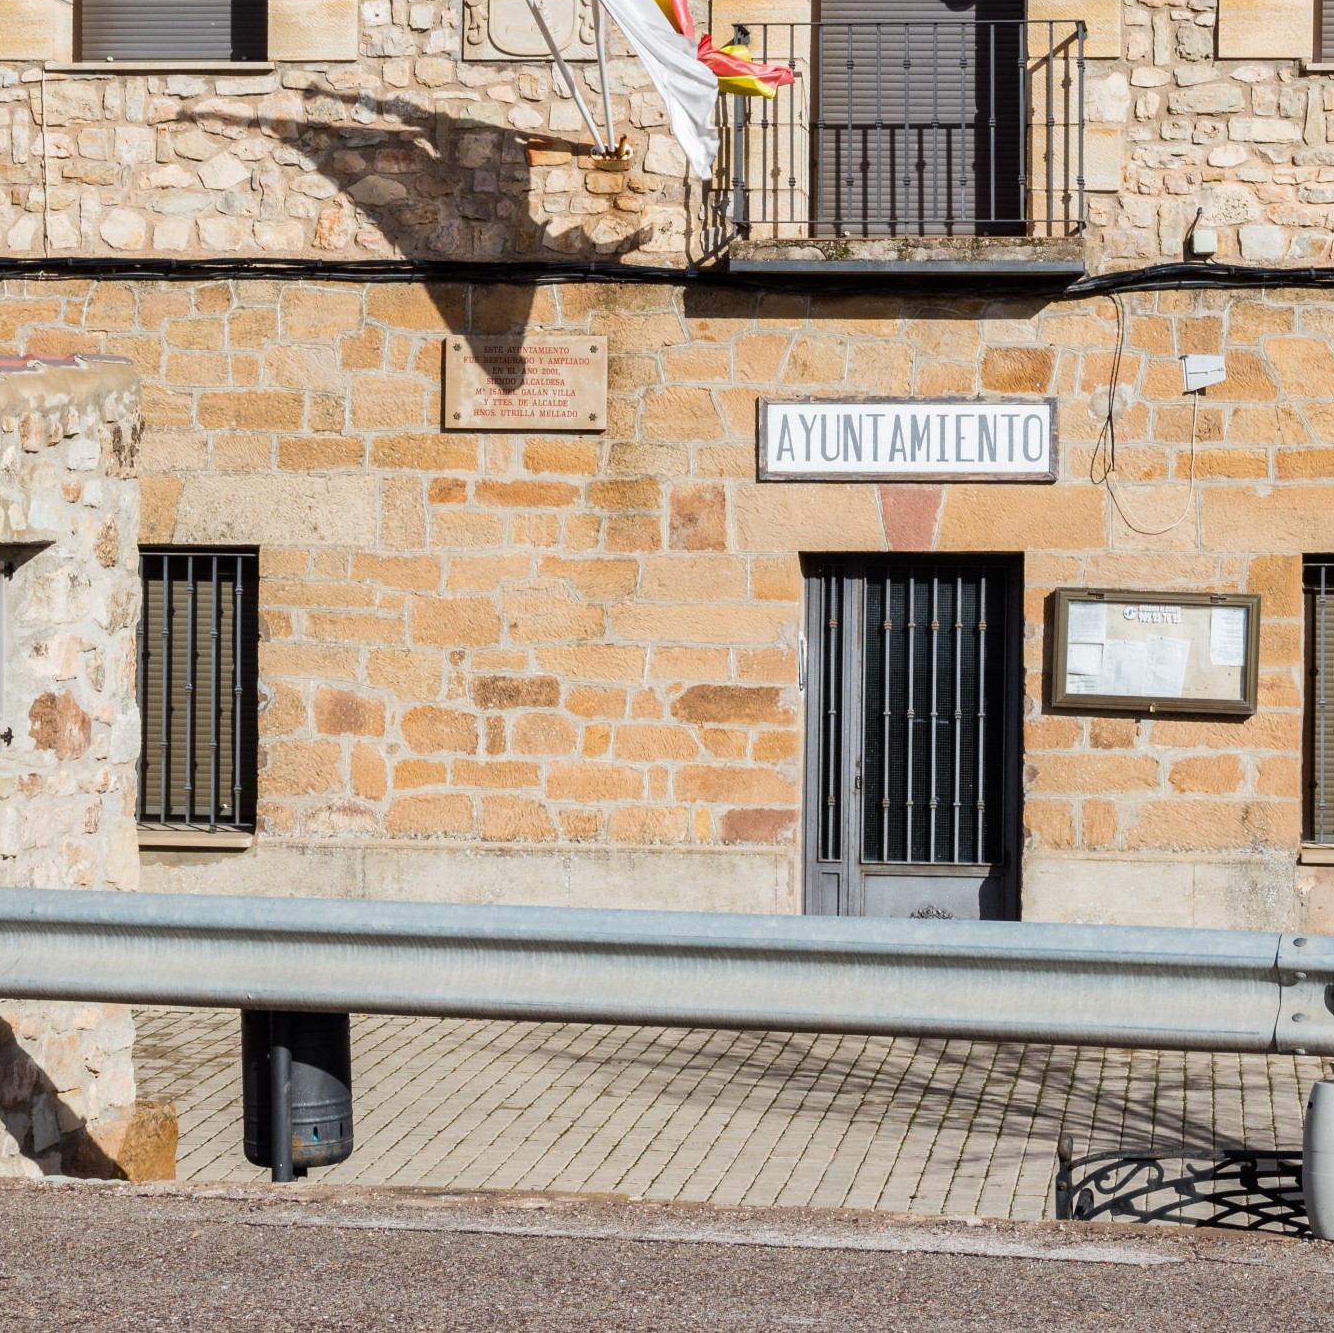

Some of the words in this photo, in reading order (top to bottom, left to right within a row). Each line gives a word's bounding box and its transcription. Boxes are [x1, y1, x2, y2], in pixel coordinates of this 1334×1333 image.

[484, 346, 503, 354] ESTE
[507, 346, 570, 354] AYUNTAMIENTO
[483, 356, 535, 365] RESTAURADO
[538, 357, 544, 365] Y
[548, 357, 590, 365] AMPLIADO
[492, 367, 503, 375] EN
[507, 367, 517, 375] EL
[521, 366, 538, 375] AÑO
[486, 377, 516, 385] SIENDO
[520, 378, 566, 386] ALCALDESA
[489, 388, 517, 396] ISABEL
[552, 389, 576, 397] VILLA
[532, 399, 568, 407] ALCALDE
[500, 409, 536, 417] UTRILLA
[539, 410, 578, 418] MELLADO
[775, 413, 1044, 463] AYUNTAMIENTO
